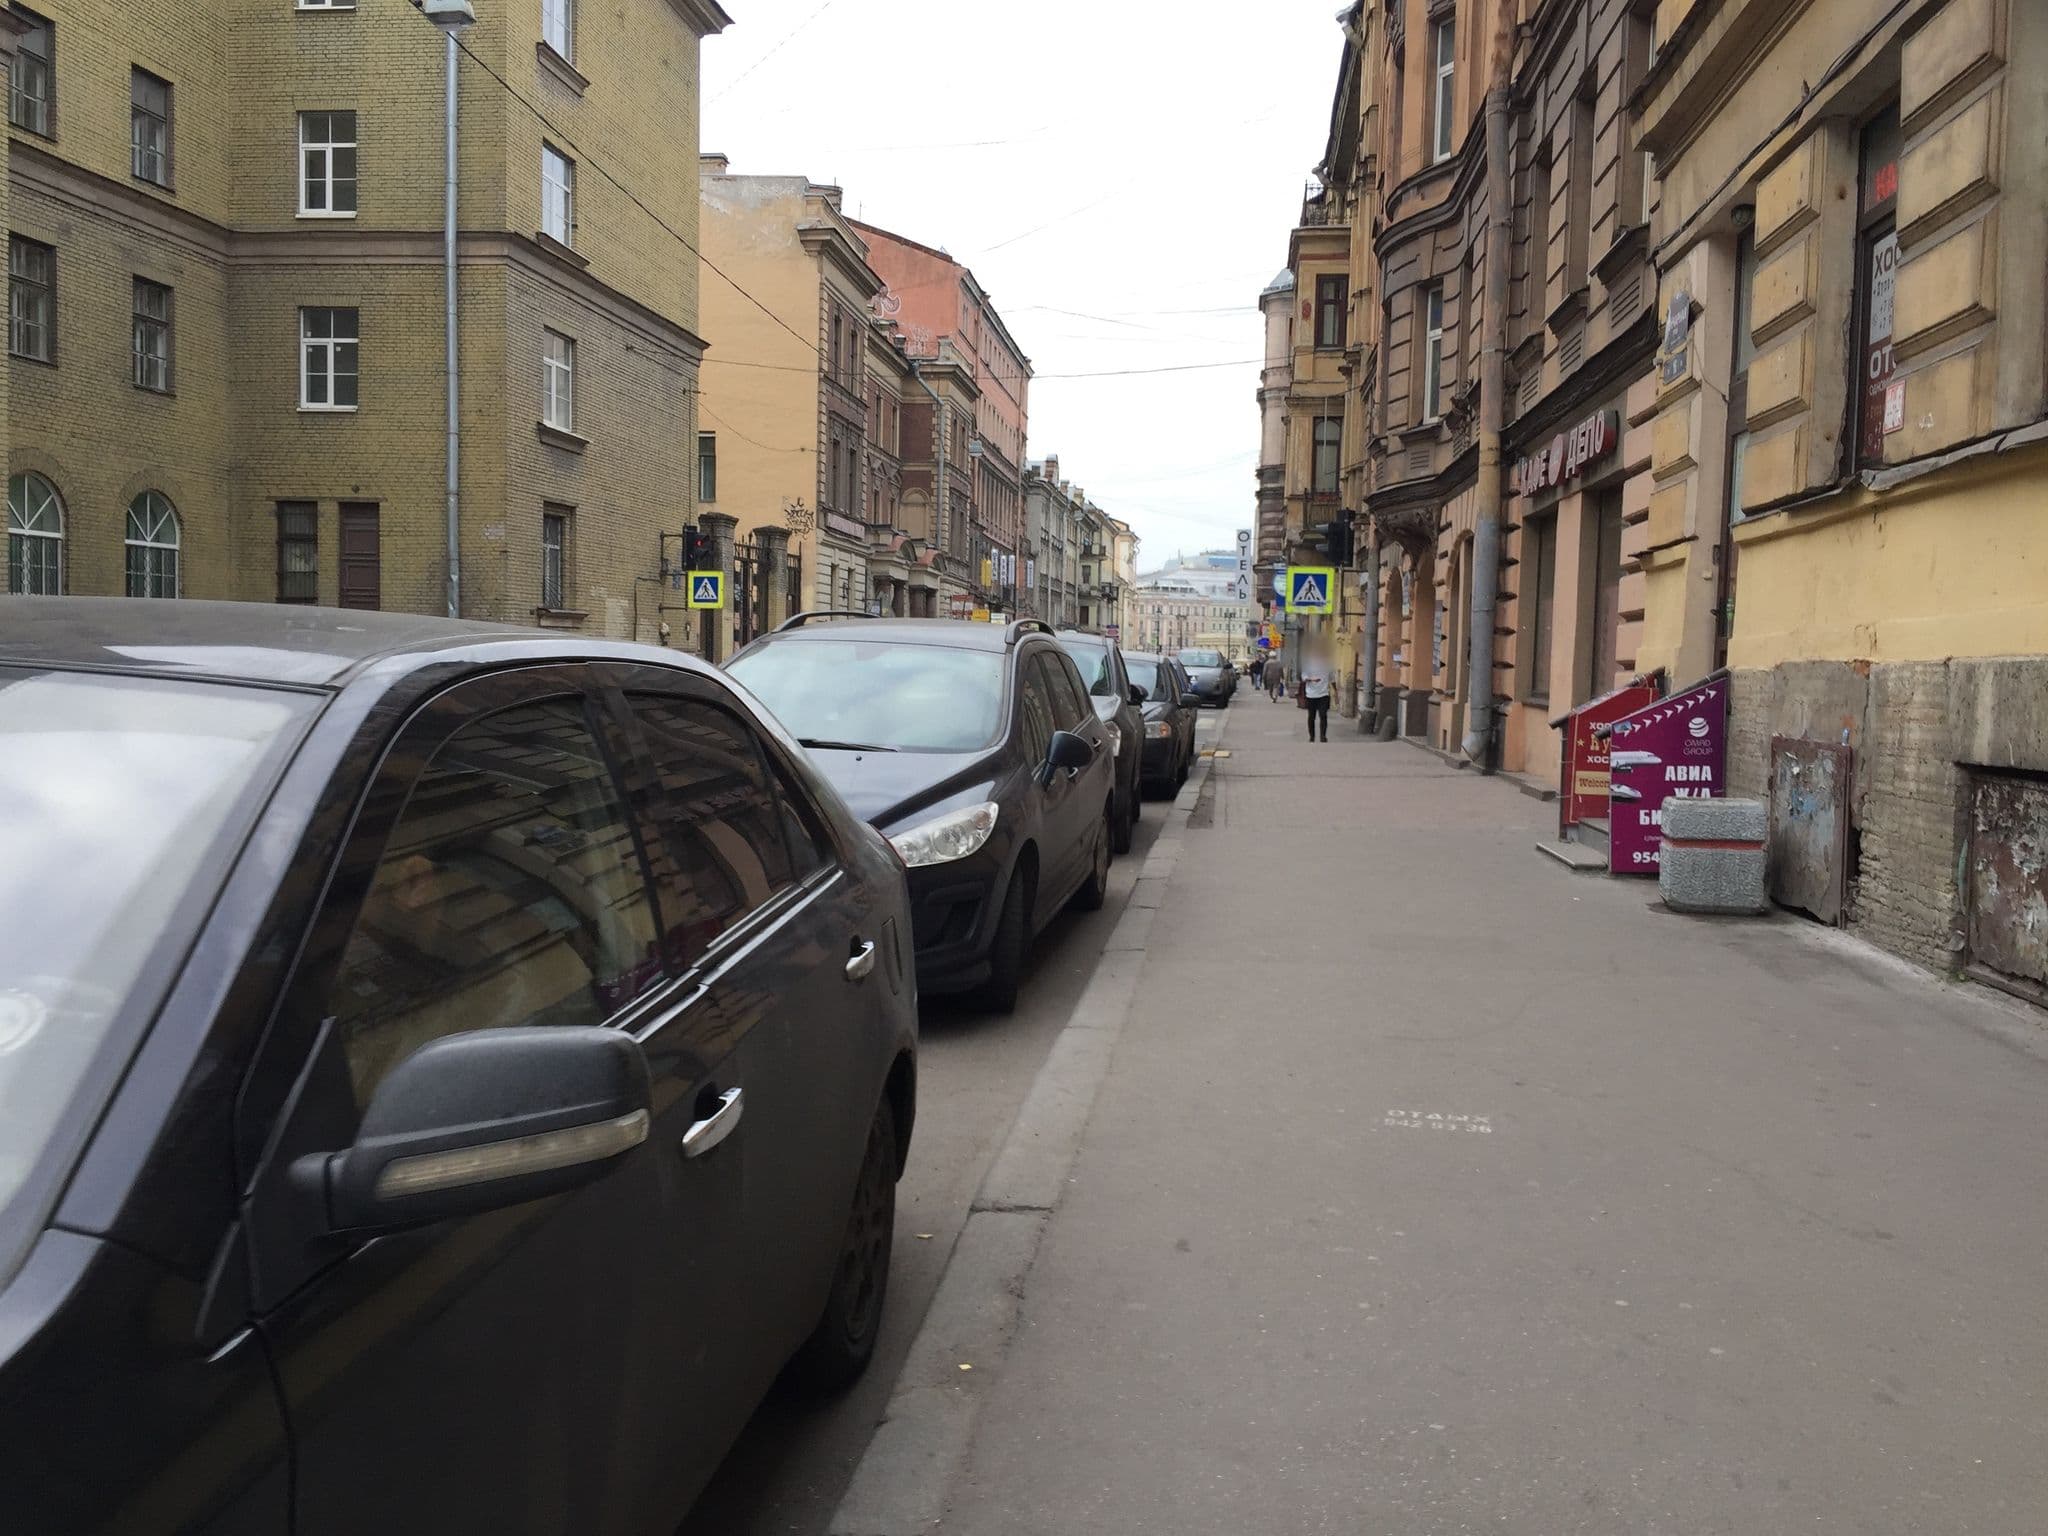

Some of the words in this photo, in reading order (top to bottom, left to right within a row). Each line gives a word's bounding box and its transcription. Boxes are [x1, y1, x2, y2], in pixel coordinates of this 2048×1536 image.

[1869, 343, 1897, 379] ОТ
[1565, 409, 1605, 479] ДЕПО
[1237, 531, 1250, 600] ОТЕЛЬ
[1664, 765, 1713, 781] АВИА
[1632, 851, 1660, 863] 954
